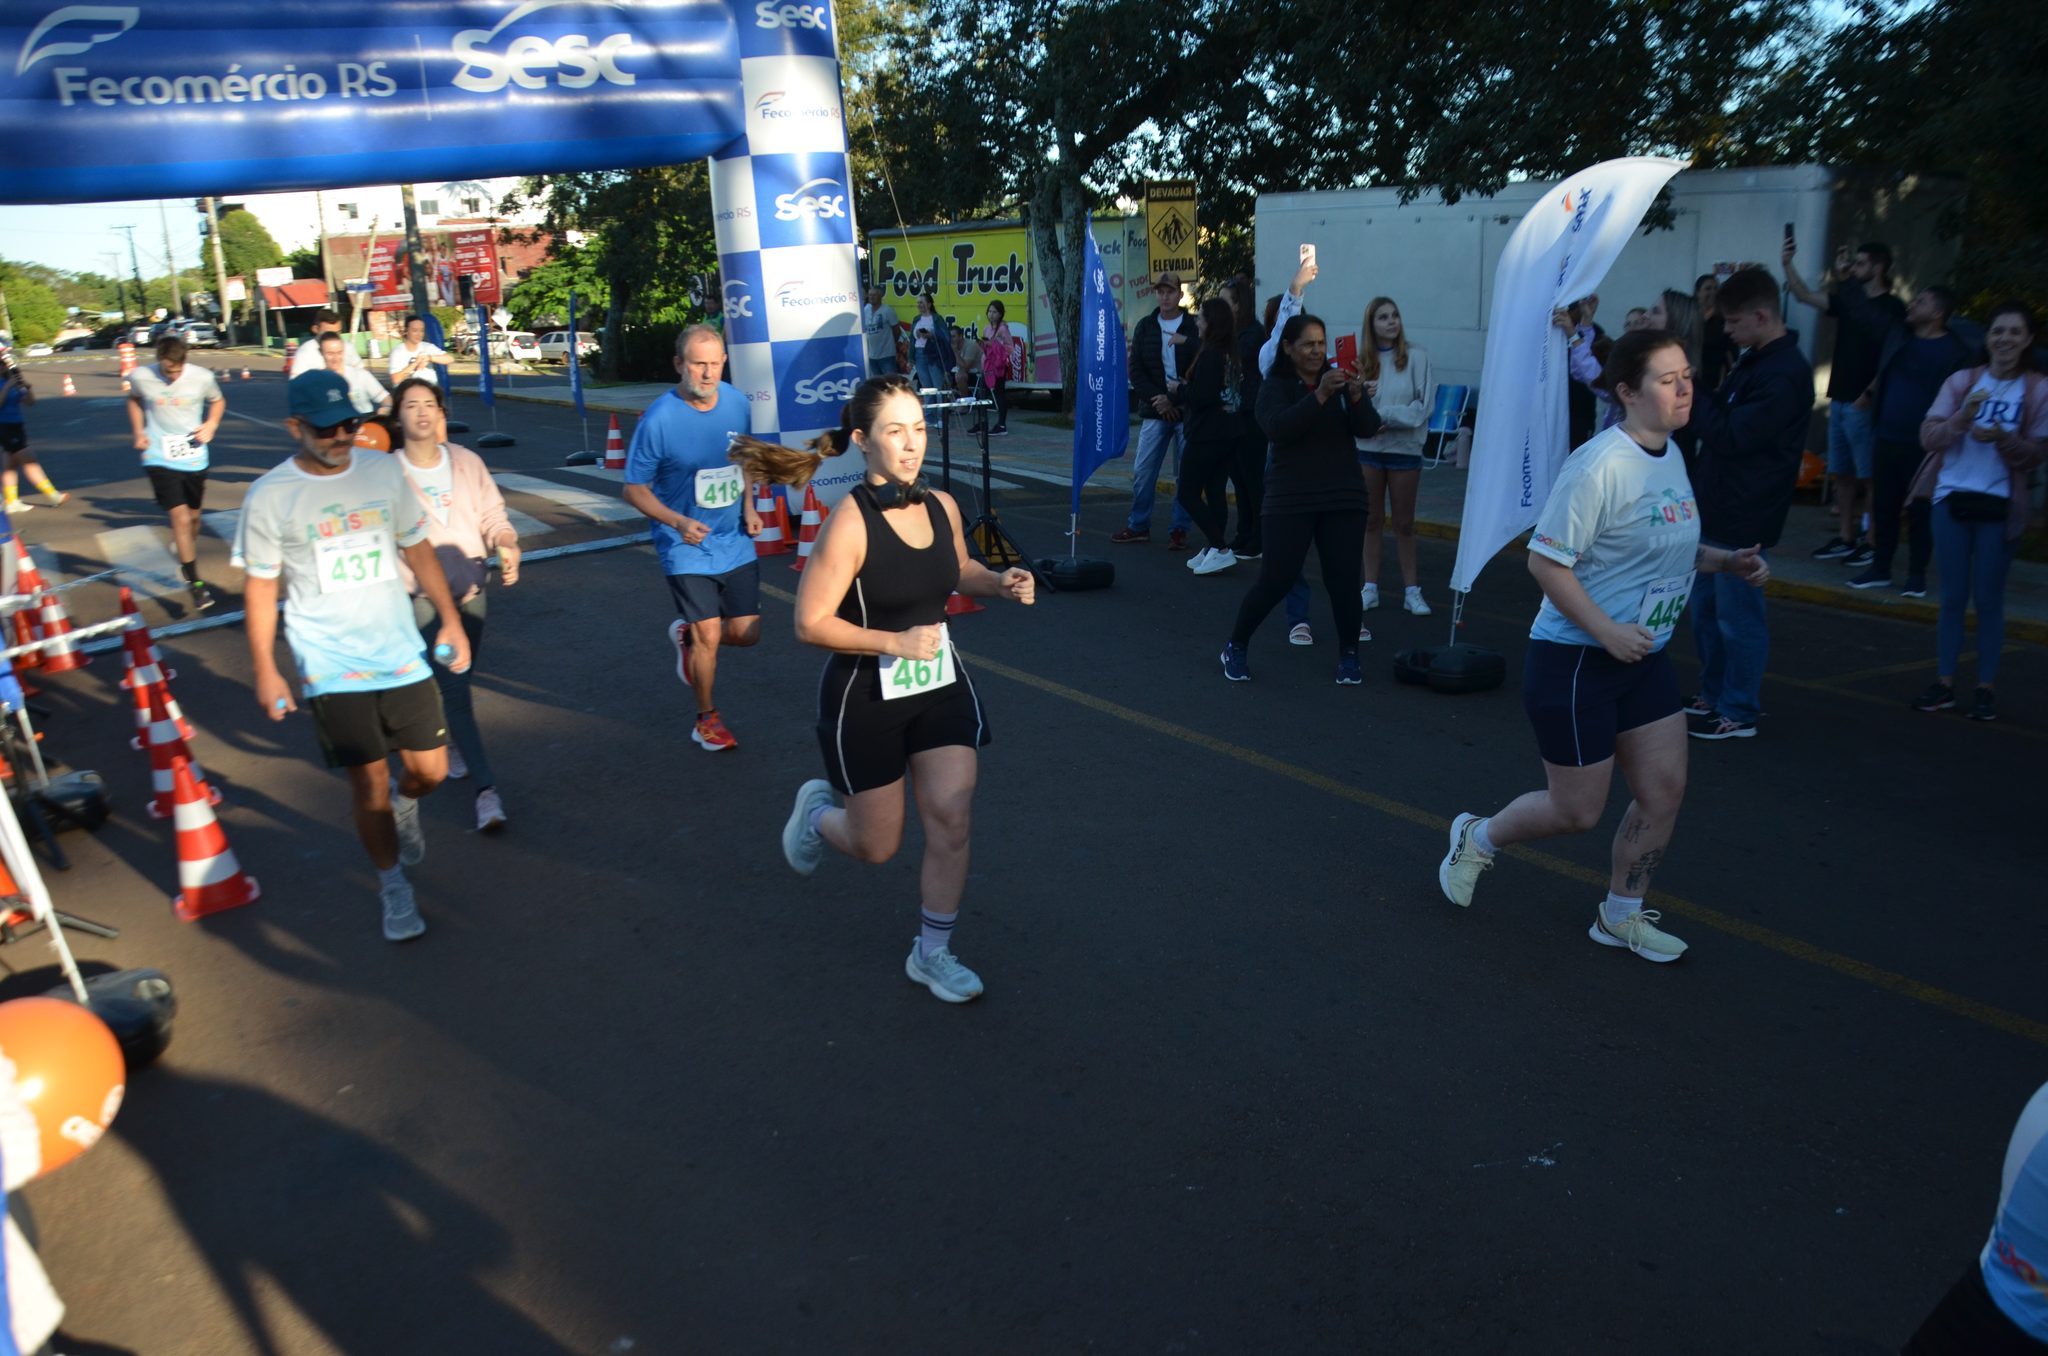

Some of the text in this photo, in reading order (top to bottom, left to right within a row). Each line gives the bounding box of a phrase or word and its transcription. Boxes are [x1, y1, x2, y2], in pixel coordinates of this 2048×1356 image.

[452, 28, 637, 93] Sesc
[55, 62, 397, 106] Fecomércio RS
[773, 193, 846, 221] Sesc
[1150, 186, 1192, 198] DEVAGAR
[878, 243, 1025, 297] Food Truck
[1153, 259, 1194, 272] ELEVADA
[1095, 376, 1103, 391] RS
[704, 479, 740, 504] 418
[331, 549, 382, 583] 437
[1646, 593, 1686, 631] 445
[892, 648, 944, 689] 467
